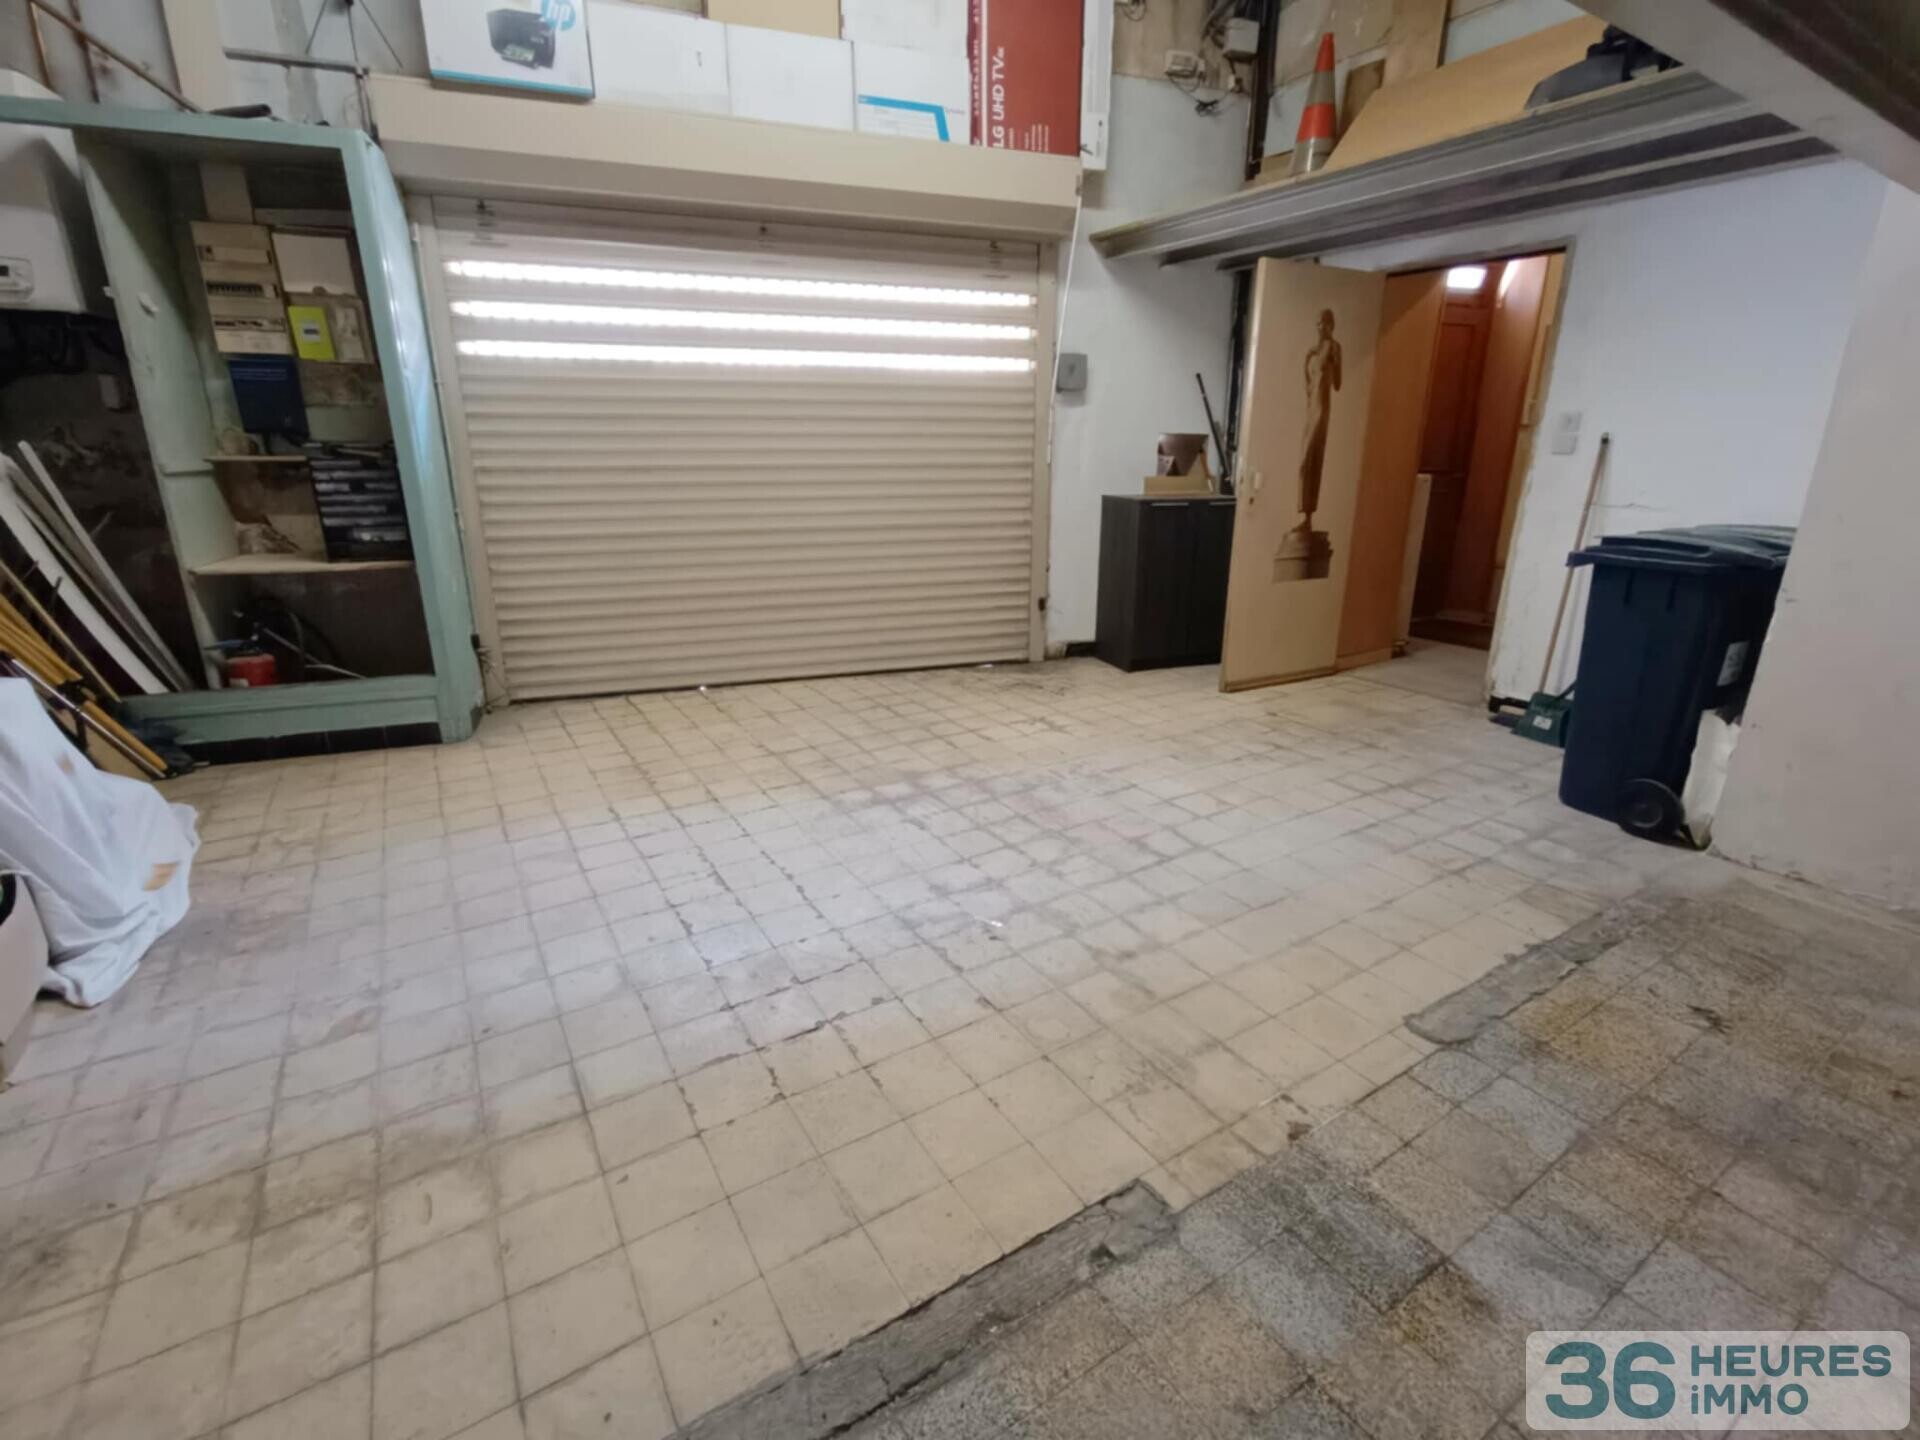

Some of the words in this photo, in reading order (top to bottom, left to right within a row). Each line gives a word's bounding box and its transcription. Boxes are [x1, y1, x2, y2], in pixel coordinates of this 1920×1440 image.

[544, 0, 572, 31] hp
[992, 84, 1005, 121] UHD
[992, 125, 1005, 148] LG
